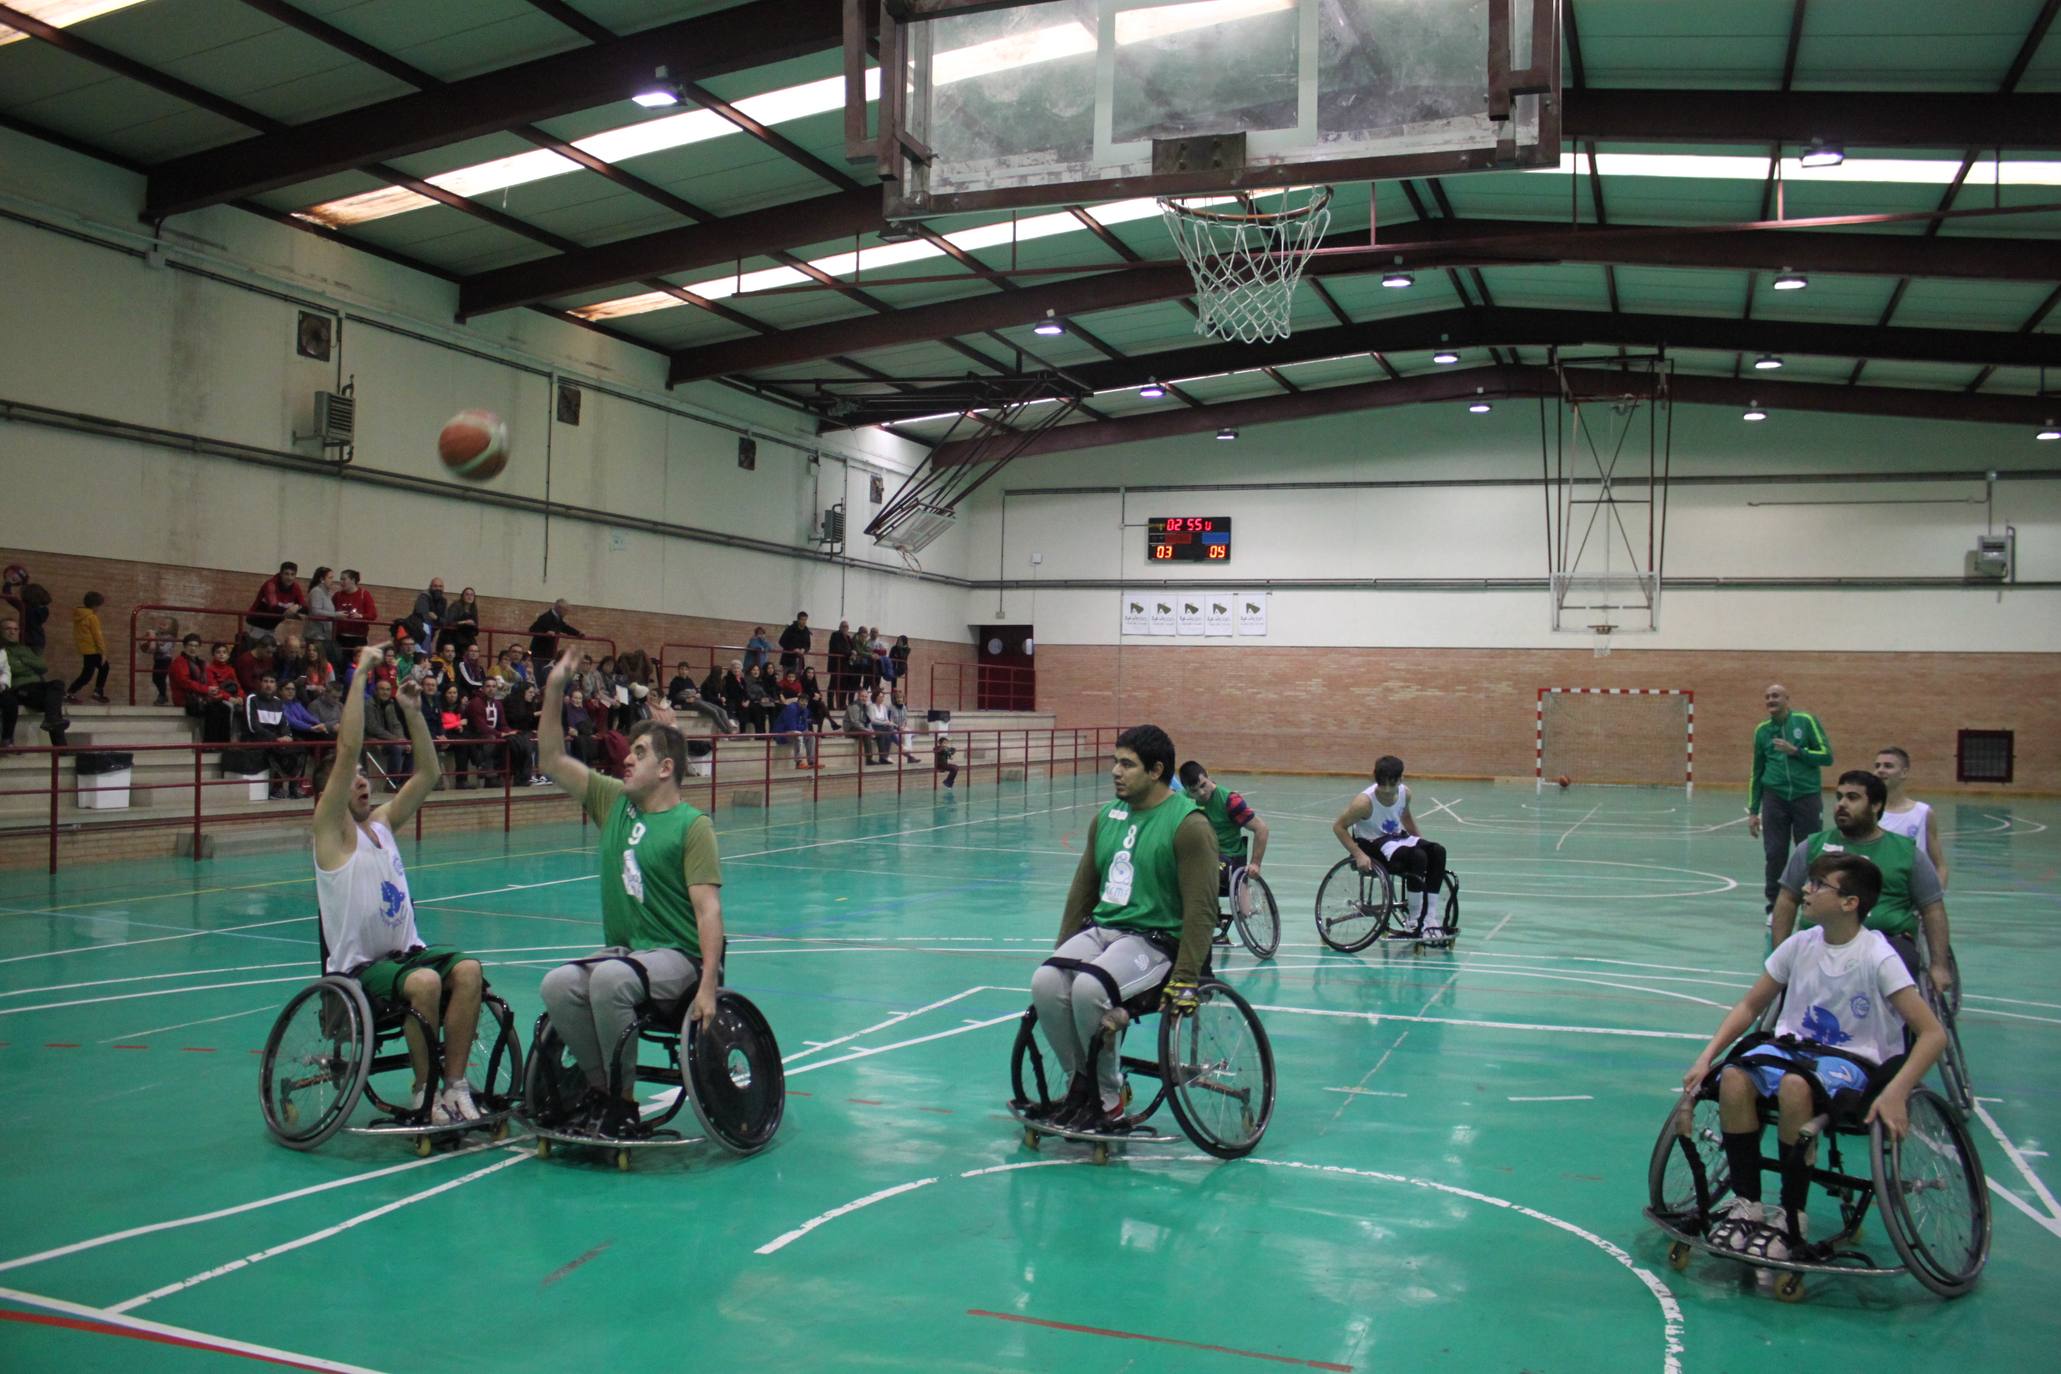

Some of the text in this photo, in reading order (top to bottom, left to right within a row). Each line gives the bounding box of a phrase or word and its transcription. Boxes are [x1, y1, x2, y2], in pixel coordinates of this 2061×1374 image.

[1166, 519, 1183, 531] 02
[1156, 545, 1173, 558] 03
[627, 822, 647, 846] 9
[1122, 824, 1137, 849] 8
